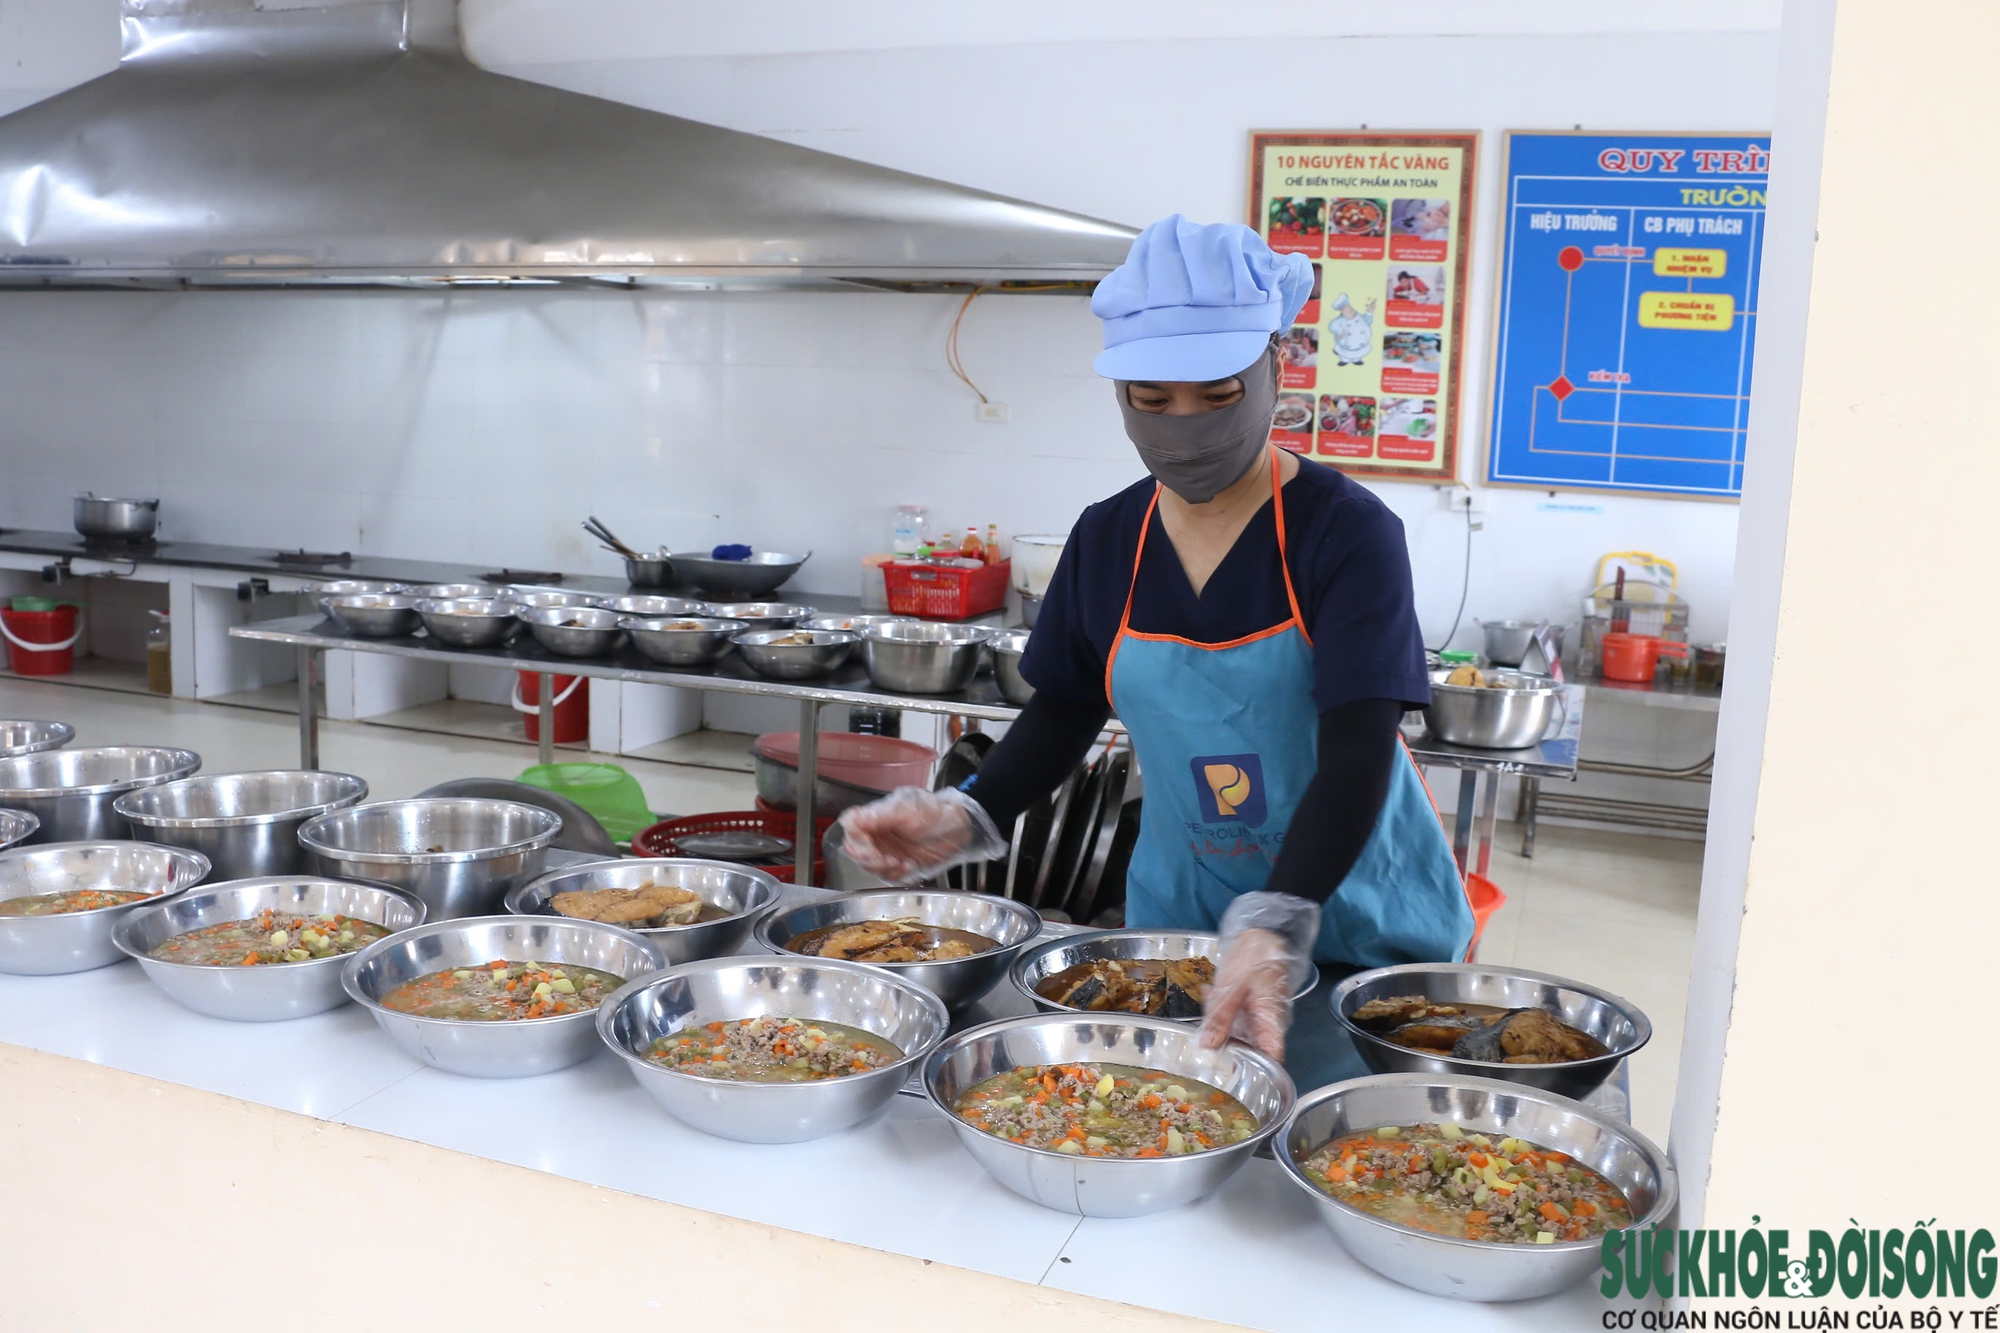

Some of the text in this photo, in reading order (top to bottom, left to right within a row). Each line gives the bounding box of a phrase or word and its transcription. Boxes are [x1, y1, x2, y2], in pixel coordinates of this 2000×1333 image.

[1277, 152, 1450, 170] 10 NGUYÊN TẮC VÀNG
[1599, 147, 1685, 173] QUY
[1285, 175, 1304, 186] CHẾ
[1306, 175, 1328, 186] BIẾN
[1331, 177, 1357, 188] THỰC
[1393, 178, 1407, 188] AN
[1410, 177, 1438, 188] TOÀN
[1530, 211, 1562, 233] HIỆU
[1644, 215, 1743, 237] CB PHỤ TRÁCH
